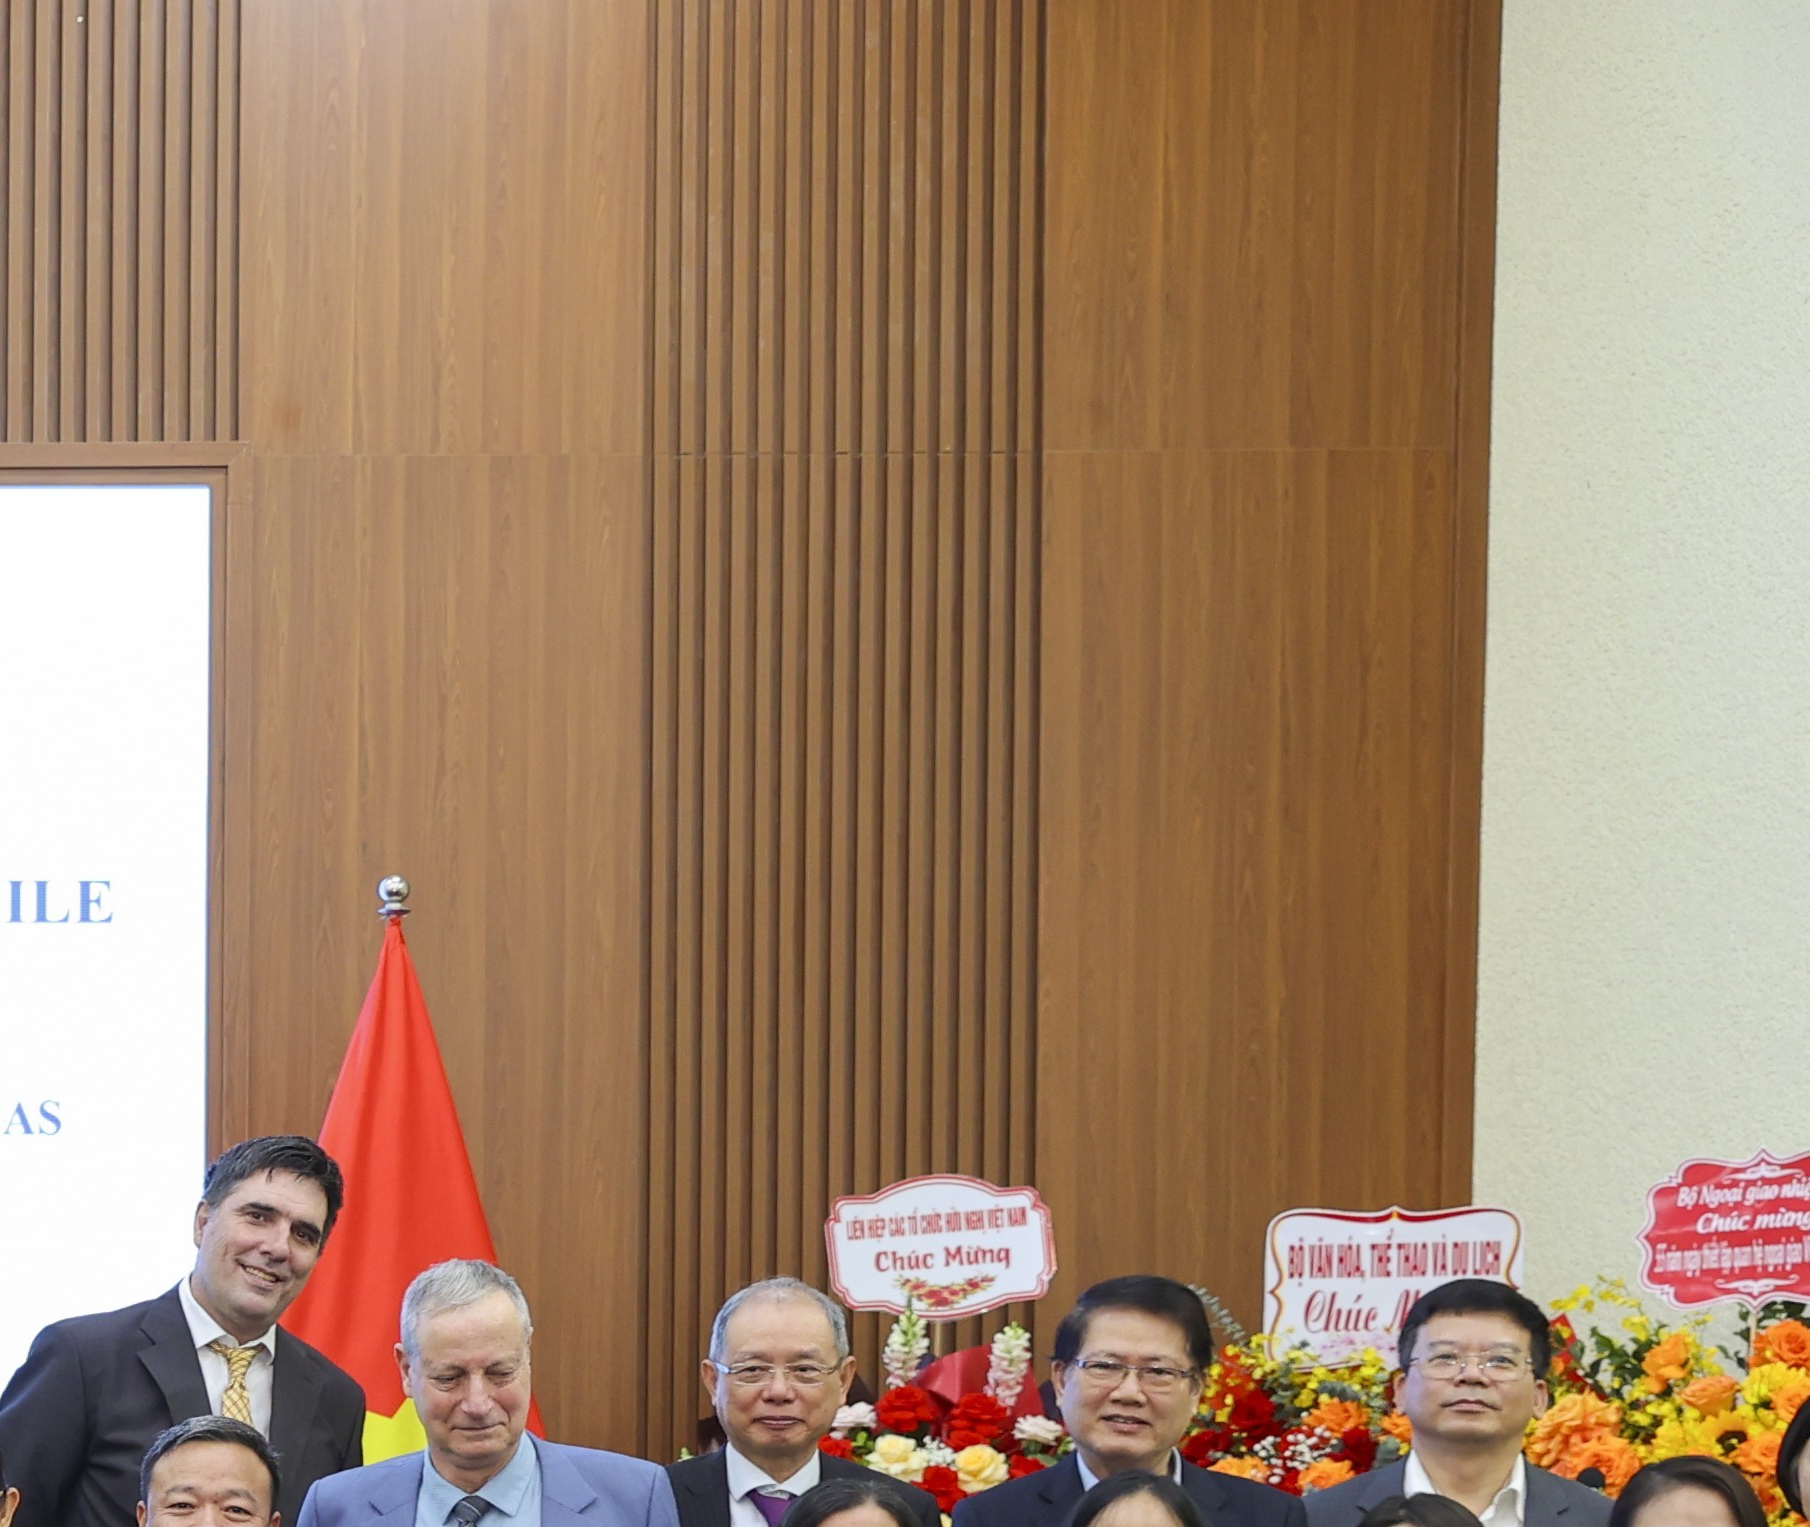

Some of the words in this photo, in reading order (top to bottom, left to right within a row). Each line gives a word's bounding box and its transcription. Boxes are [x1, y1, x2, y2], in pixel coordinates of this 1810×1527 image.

[1677, 1186, 1698, 1210] Bộ
[1699, 1182, 1744, 1208] Ngoại
[1744, 1181, 1779, 1206] giao
[847, 1216, 864, 1240] LIÊN
[867, 1214, 886, 1243] HIỆP
[889, 1212, 905, 1237] CÁC
[987, 1204, 1004, 1234] VIỆT
[1007, 1206, 1027, 1228] NAM
[1696, 1211, 1752, 1234] Chúc
[874, 1249, 934, 1272] Chúc
[944, 1245, 1011, 1268] Mừng
[1288, 1237, 1306, 1288] BỘ
[1309, 1237, 1334, 1278] VĂN
[1337, 1235, 1366, 1282] HÓA,
[1369, 1228, 1395, 1278] THỂ
[1397, 1242, 1429, 1277] THAO
[1432, 1233, 1448, 1276] VÀ
[1452, 1241, 1470, 1275] DU
[1304, 1288, 1378, 1333] Chúc
